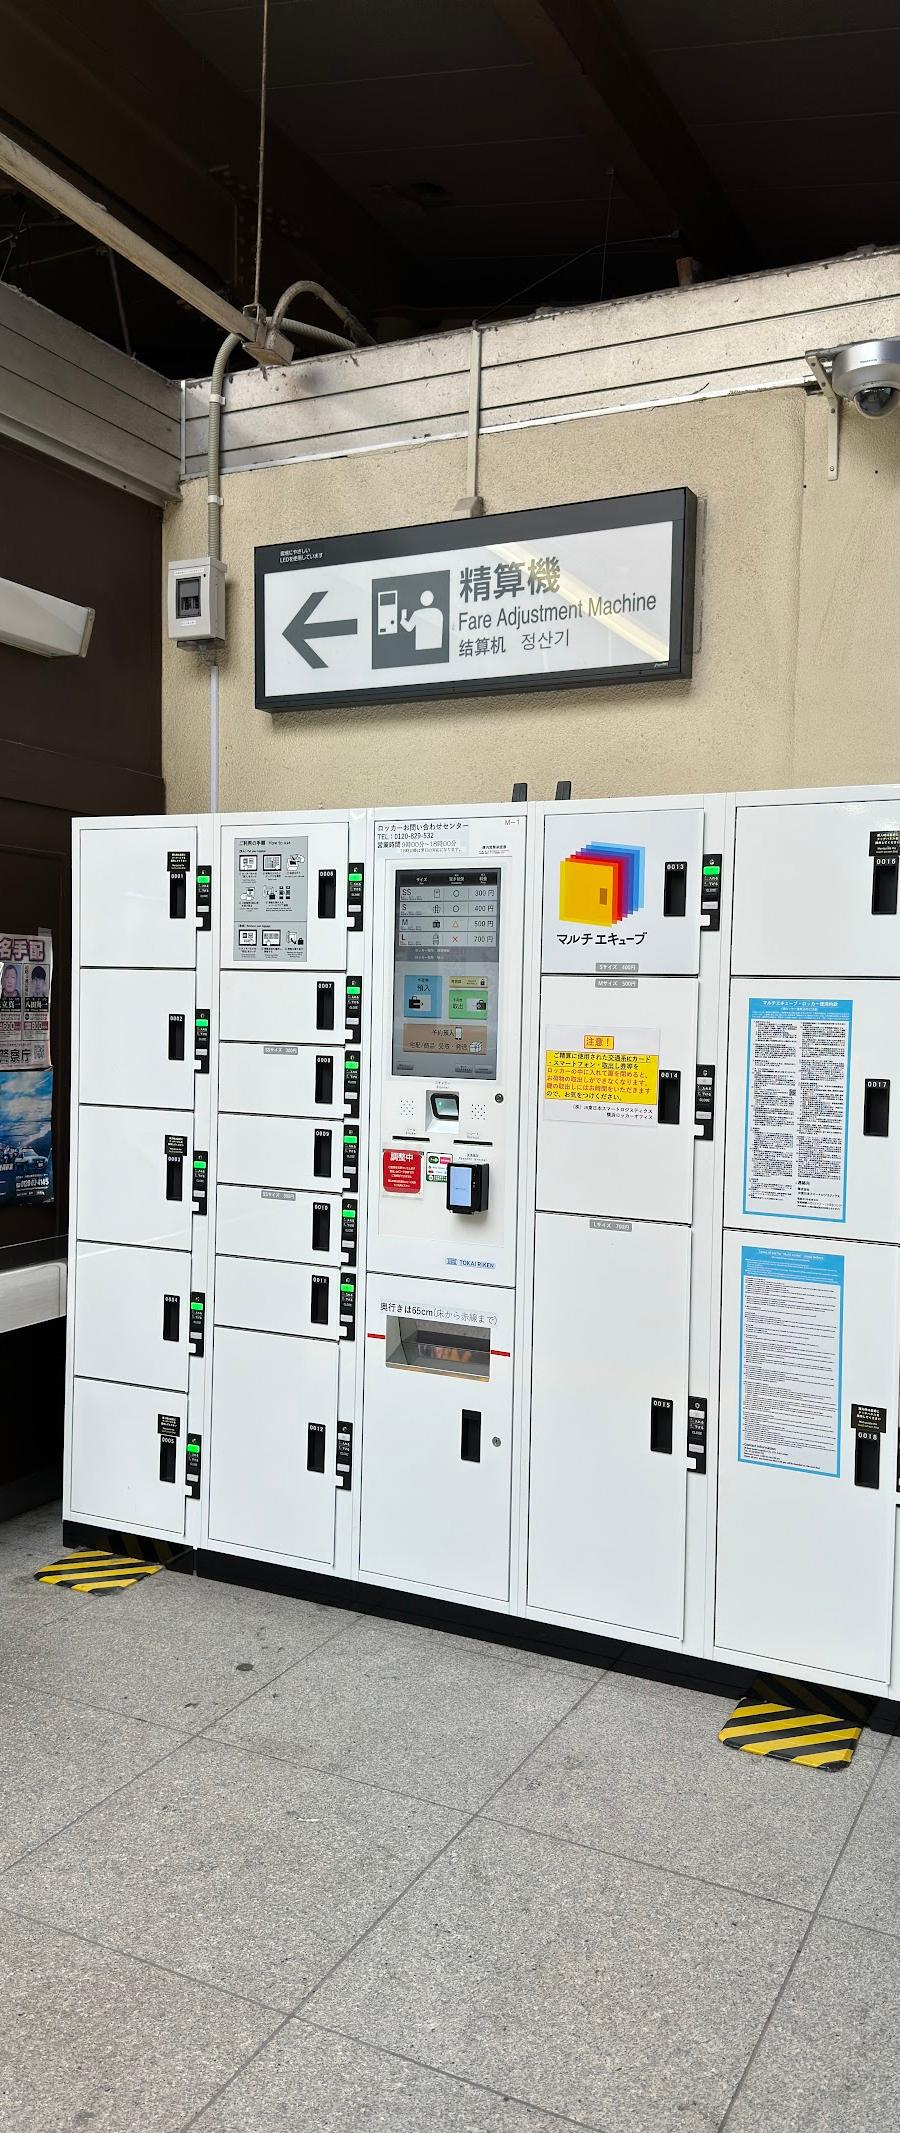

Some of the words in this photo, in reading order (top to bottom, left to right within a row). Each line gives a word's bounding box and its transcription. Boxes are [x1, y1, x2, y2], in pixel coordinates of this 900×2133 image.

[459, 556, 561, 603] 精算機
[458, 612, 492, 631] Fare
[496, 598, 583, 630] Adjustment
[588, 593, 657, 617] Machine
[521, 629, 570, 651] 정산기
[458, 636, 507, 658] 结算机
[377, 822, 470, 832] ロッカーお問い合わせセンター
[0, 938, 46, 962] 名手配
[390, 1151, 414, 1162] 調整中
[459, 1259, 477, 1267] TOKAI
[477, 1261, 495, 1269] RIKEN
[653, 1399, 671, 1408] 0015
[309, 1424, 324, 1432] 0012
[161, 1436, 175, 1444] 0005
[857, 1431, 878, 1440] 0018
